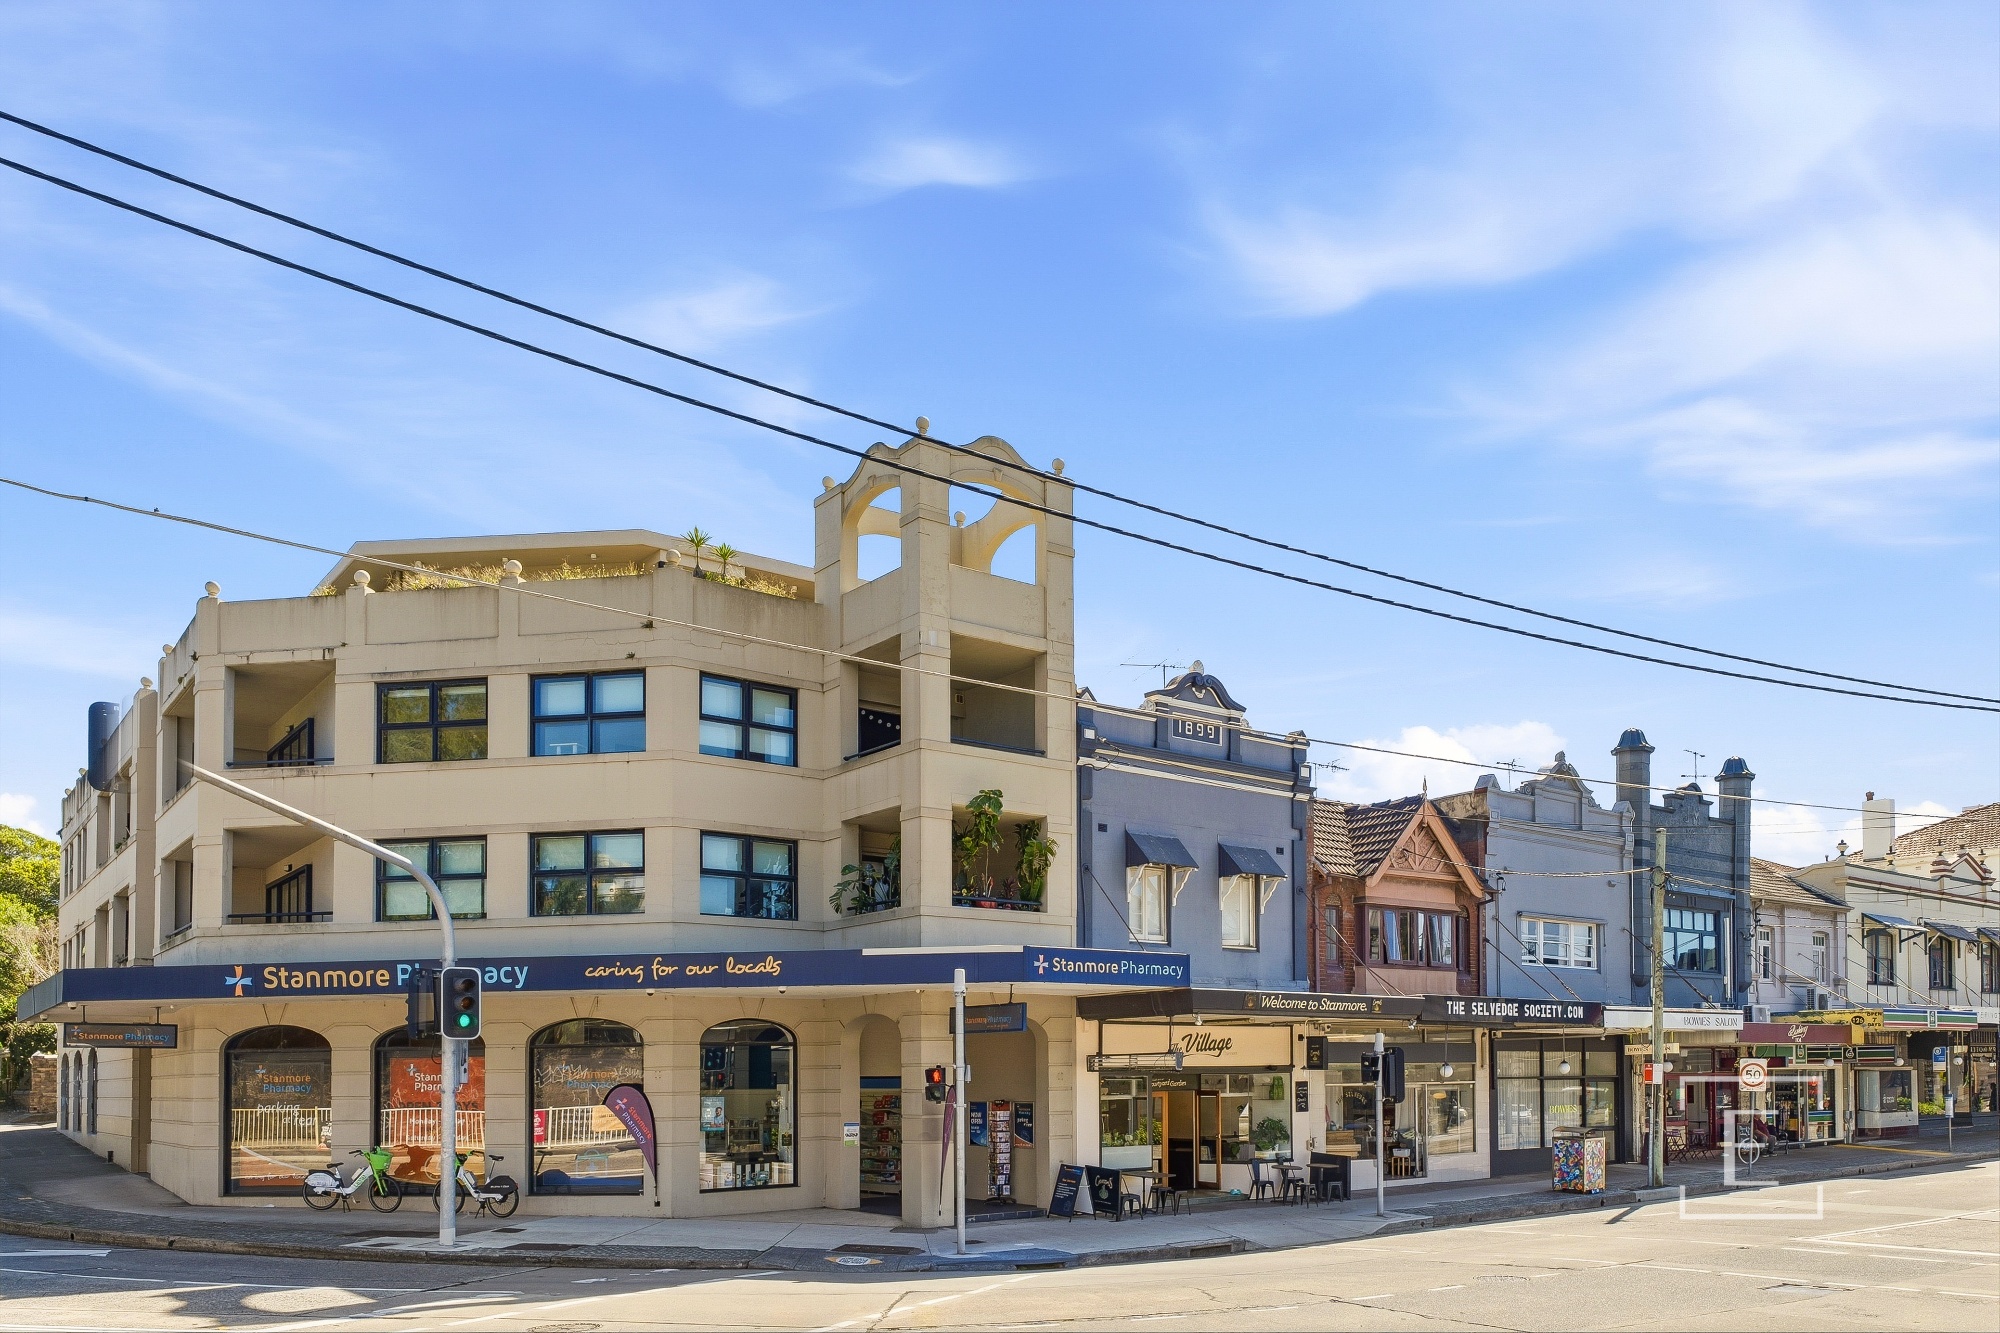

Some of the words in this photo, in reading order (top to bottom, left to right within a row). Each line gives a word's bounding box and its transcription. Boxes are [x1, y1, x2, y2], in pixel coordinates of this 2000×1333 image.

[1178, 719, 1215, 739] 1899
[264, 966, 390, 989] Stanmore
[396, 963, 529, 989] Pacy
[584, 961, 644, 983] caring
[651, 957, 679, 980] for
[685, 963, 719, 975] our
[725, 955, 782, 976] locals
[1052, 957, 1119, 974] Stanmore
[1120, 960, 1184, 979] Pharmacy
[1261, 995, 1307, 1010] Welcome
[1307, 999, 1319, 1011] to
[1446, 1001, 1466, 1015] THE
[1471, 1002, 1519, 1017] SELVEDGE
[1524, 1004, 1584, 1019] SOCIETY.COM
[1715, 1017, 1738, 1027] SALON
[78, 1032, 123, 1040] Stanmore
[125, 1033, 169, 1042] Pharmacy
[1181, 1032, 1233, 1057] Village
[263, 1074, 311, 1083] Stanmore
[414, 1070, 442, 1082] Stan
[1745, 1069, 1761, 1080] 50
[263, 1084, 312, 1093] Pharmacy
[414, 1082, 463, 1093] Phary
[621, 1111, 646, 1144] Pharmacy
[628, 1106, 652, 1139] Stanmore
